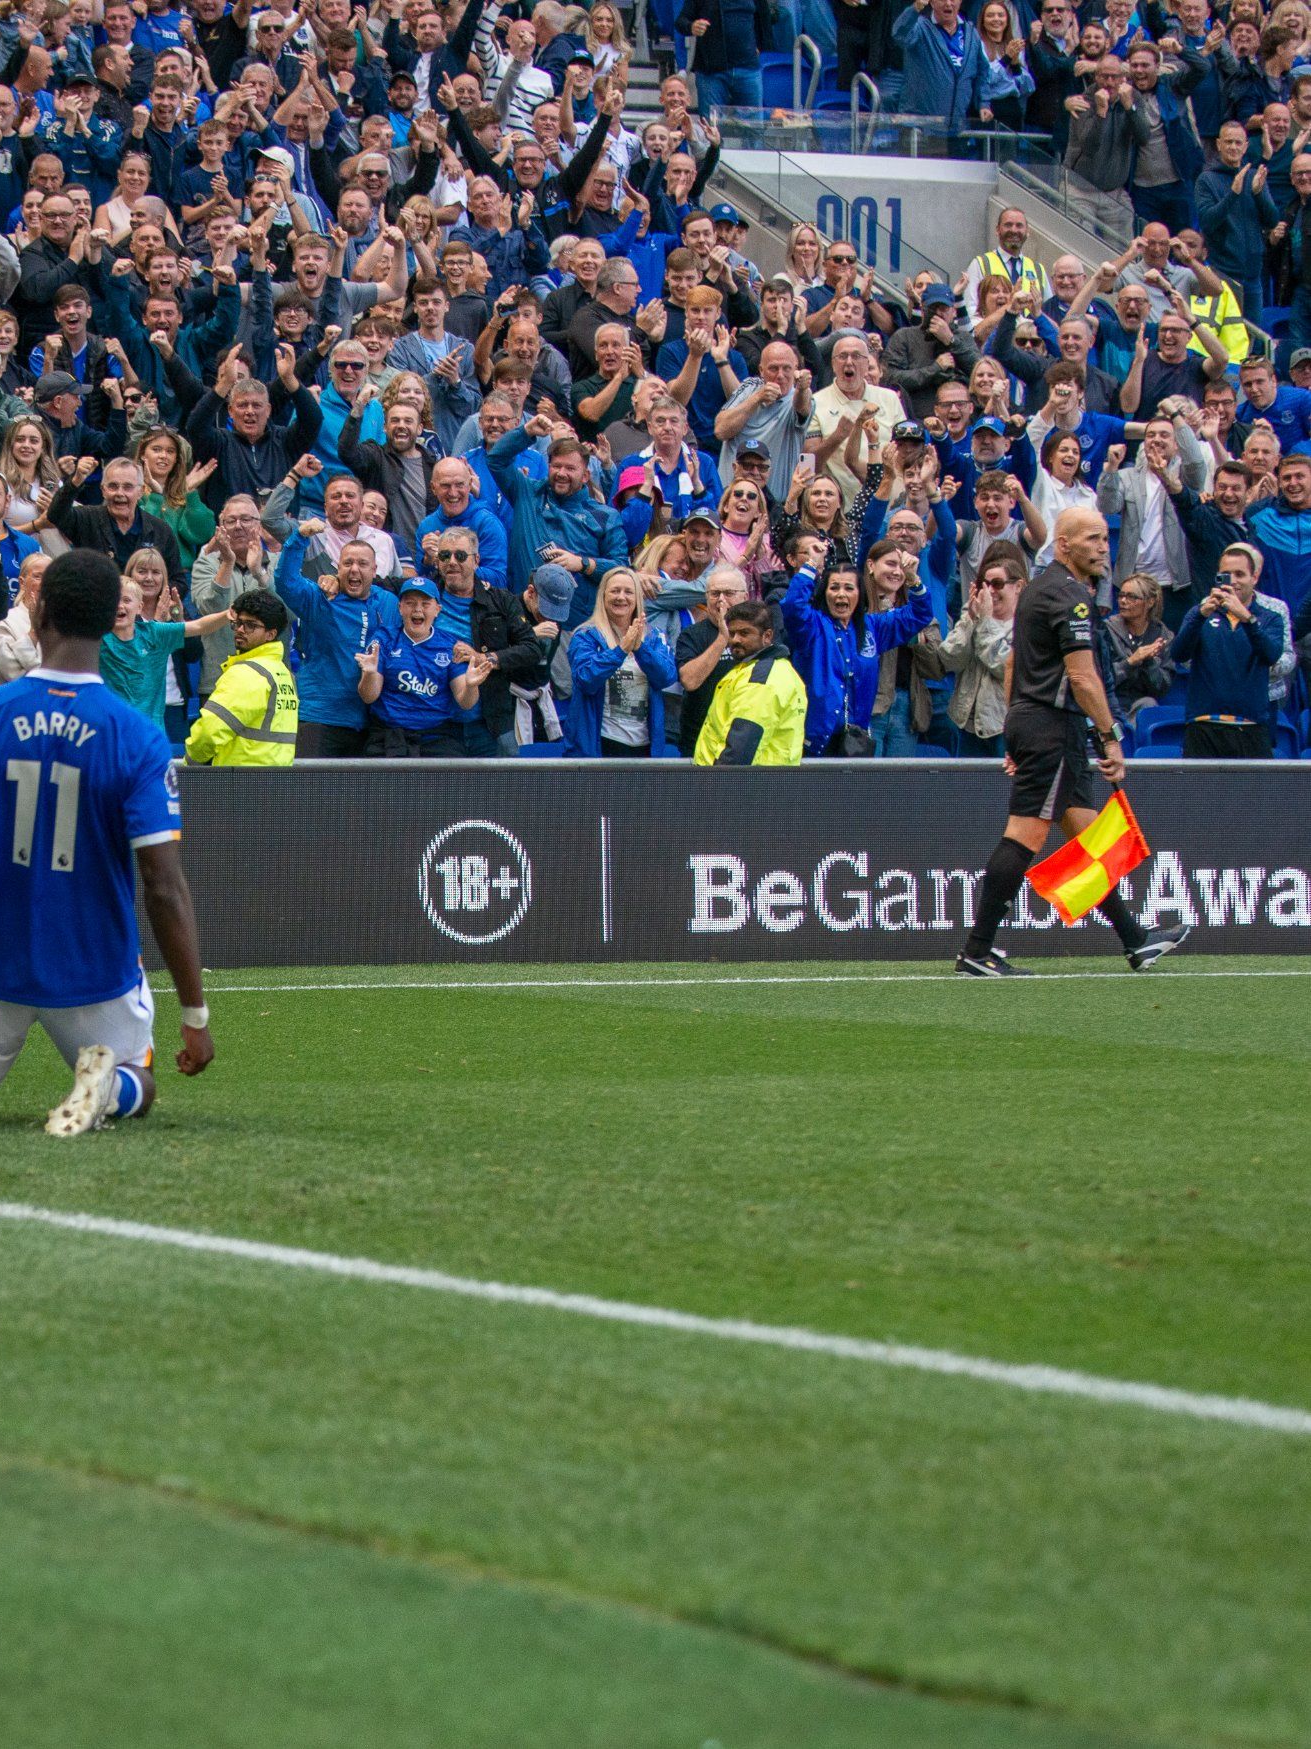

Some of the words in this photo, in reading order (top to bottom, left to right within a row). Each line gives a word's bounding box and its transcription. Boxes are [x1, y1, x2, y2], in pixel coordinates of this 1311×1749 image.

[398, 670, 438, 697] Stake
[12, 710, 97, 748] BARRY
[6, 758, 81, 872] 11
[436, 855, 519, 911] 18+
